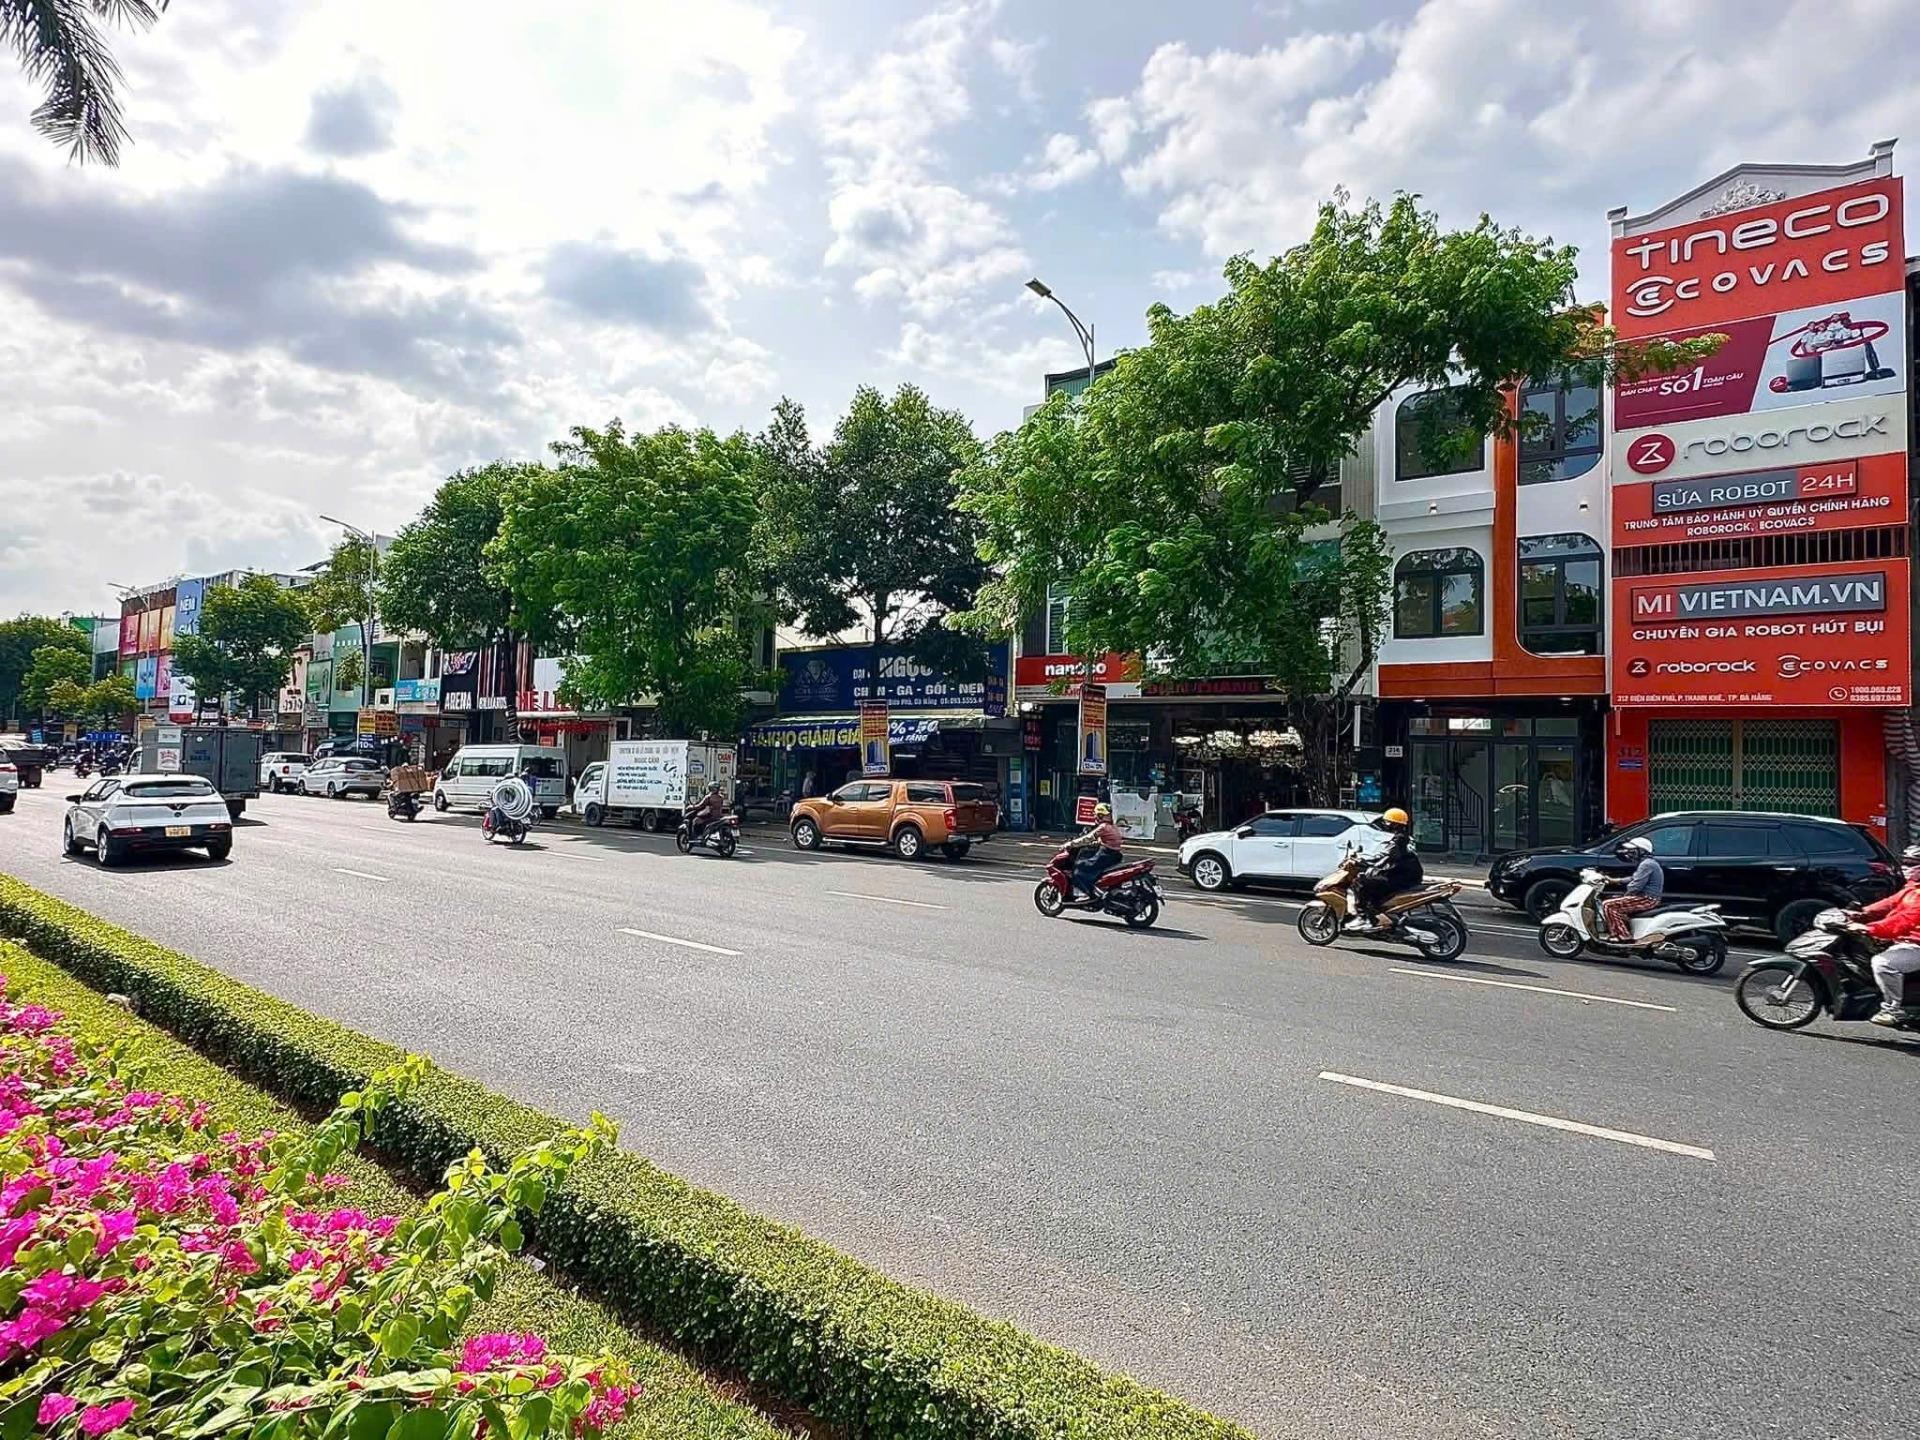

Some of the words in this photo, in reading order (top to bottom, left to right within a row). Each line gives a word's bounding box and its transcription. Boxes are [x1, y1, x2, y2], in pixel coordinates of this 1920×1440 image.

[1625, 241, 1890, 316] ECOVACS
[1659, 373, 1693, 396] SỐ
[1692, 365, 1705, 391] 1
[1682, 412, 1890, 460] roborock
[1657, 482, 1702, 509] SỬA
[1710, 480, 1792, 502] ROBOT
[1801, 473, 1854, 493] 24H
[1624, 519, 1659, 531] TRUNG
[1661, 515, 1685, 528] TÂM
[1713, 508, 1745, 522] HÀNH
[1767, 502, 1807, 518] QUYỀN
[1809, 498, 1849, 513] CHÍNH
[1850, 495, 1890, 510] HÃNG
[1686, 522, 1755, 537] ROBOROCK,
[1759, 516, 1816, 530] ECOVACS
[1637, 594, 1671, 615] MI
[1679, 581, 1880, 612] VIETNAM.VN
[1632, 626, 1699, 641] CHUYÊN
[1705, 625, 1738, 638] GIA
[1745, 623, 1806, 637] ROBOT
[1812, 618, 1847, 635] HÚT
[1854, 620, 1884, 635] BỤI
[1656, 658, 1757, 674] roborock
[1777, 655, 1888, 679] ECOVACS
[444, 691, 472, 711] ARENA
[896, 685, 914, 696] GA
[925, 681, 947, 696] GỐI
[798, 725, 836, 747] GIẢM
